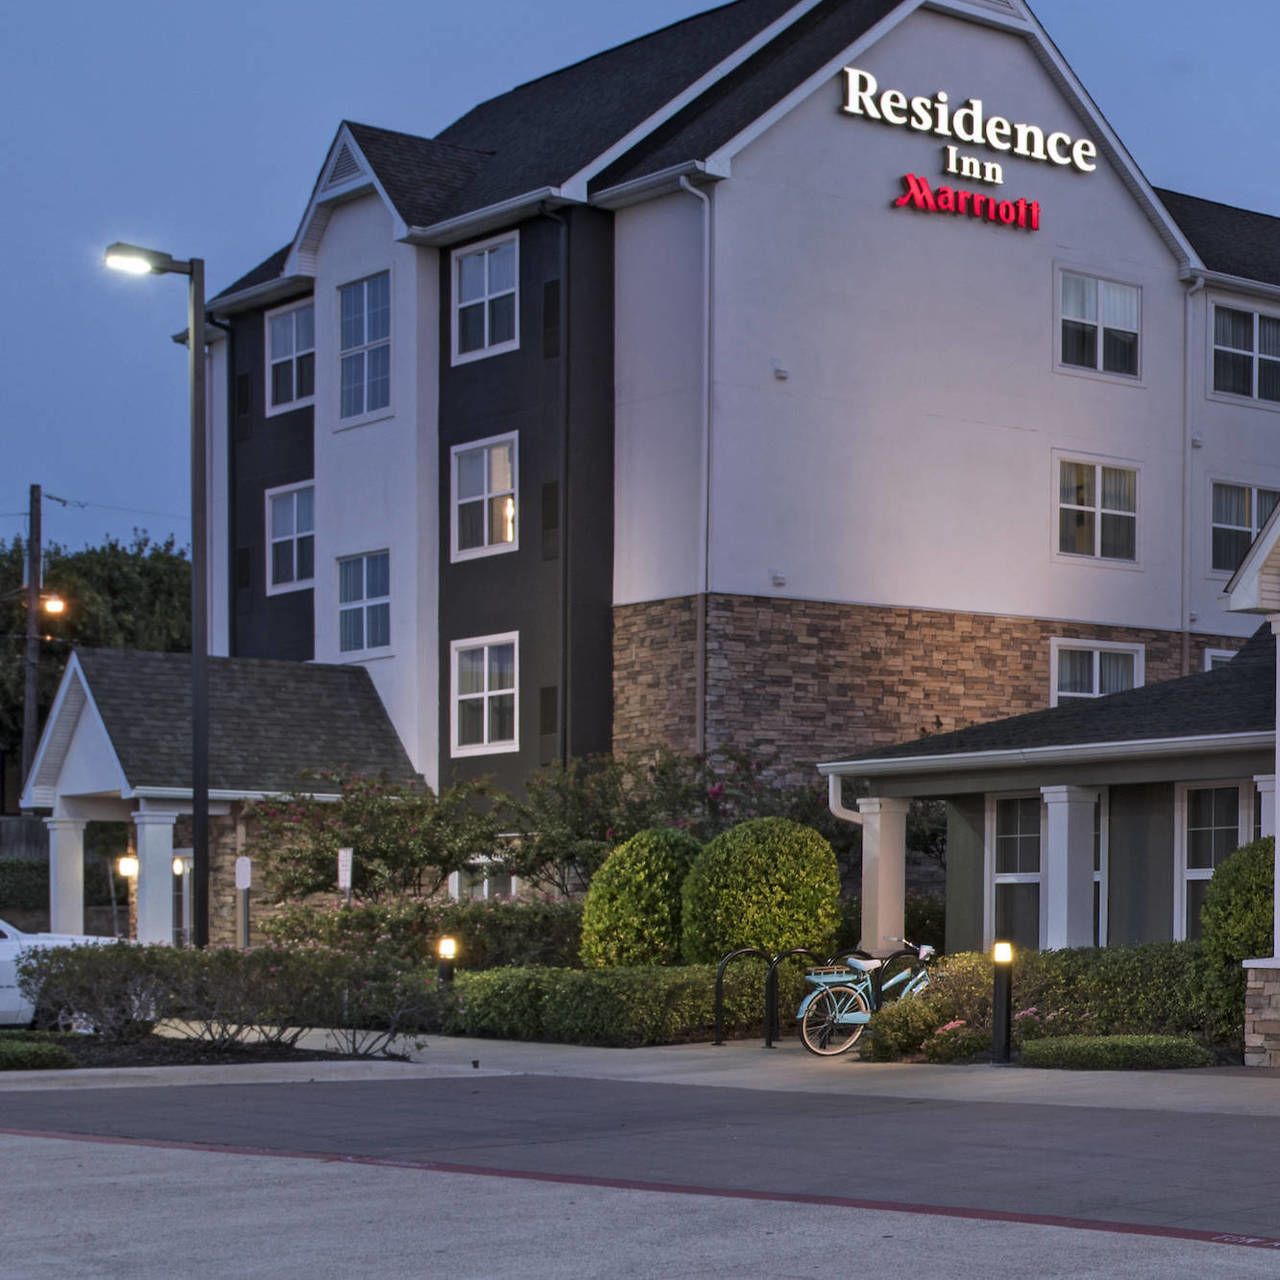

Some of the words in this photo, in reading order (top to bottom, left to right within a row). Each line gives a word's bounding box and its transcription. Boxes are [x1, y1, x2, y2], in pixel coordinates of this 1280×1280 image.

[843, 66, 1097, 172] Residence
[946, 145, 1004, 184] Inn
[895, 173, 1041, 231] Marriott
